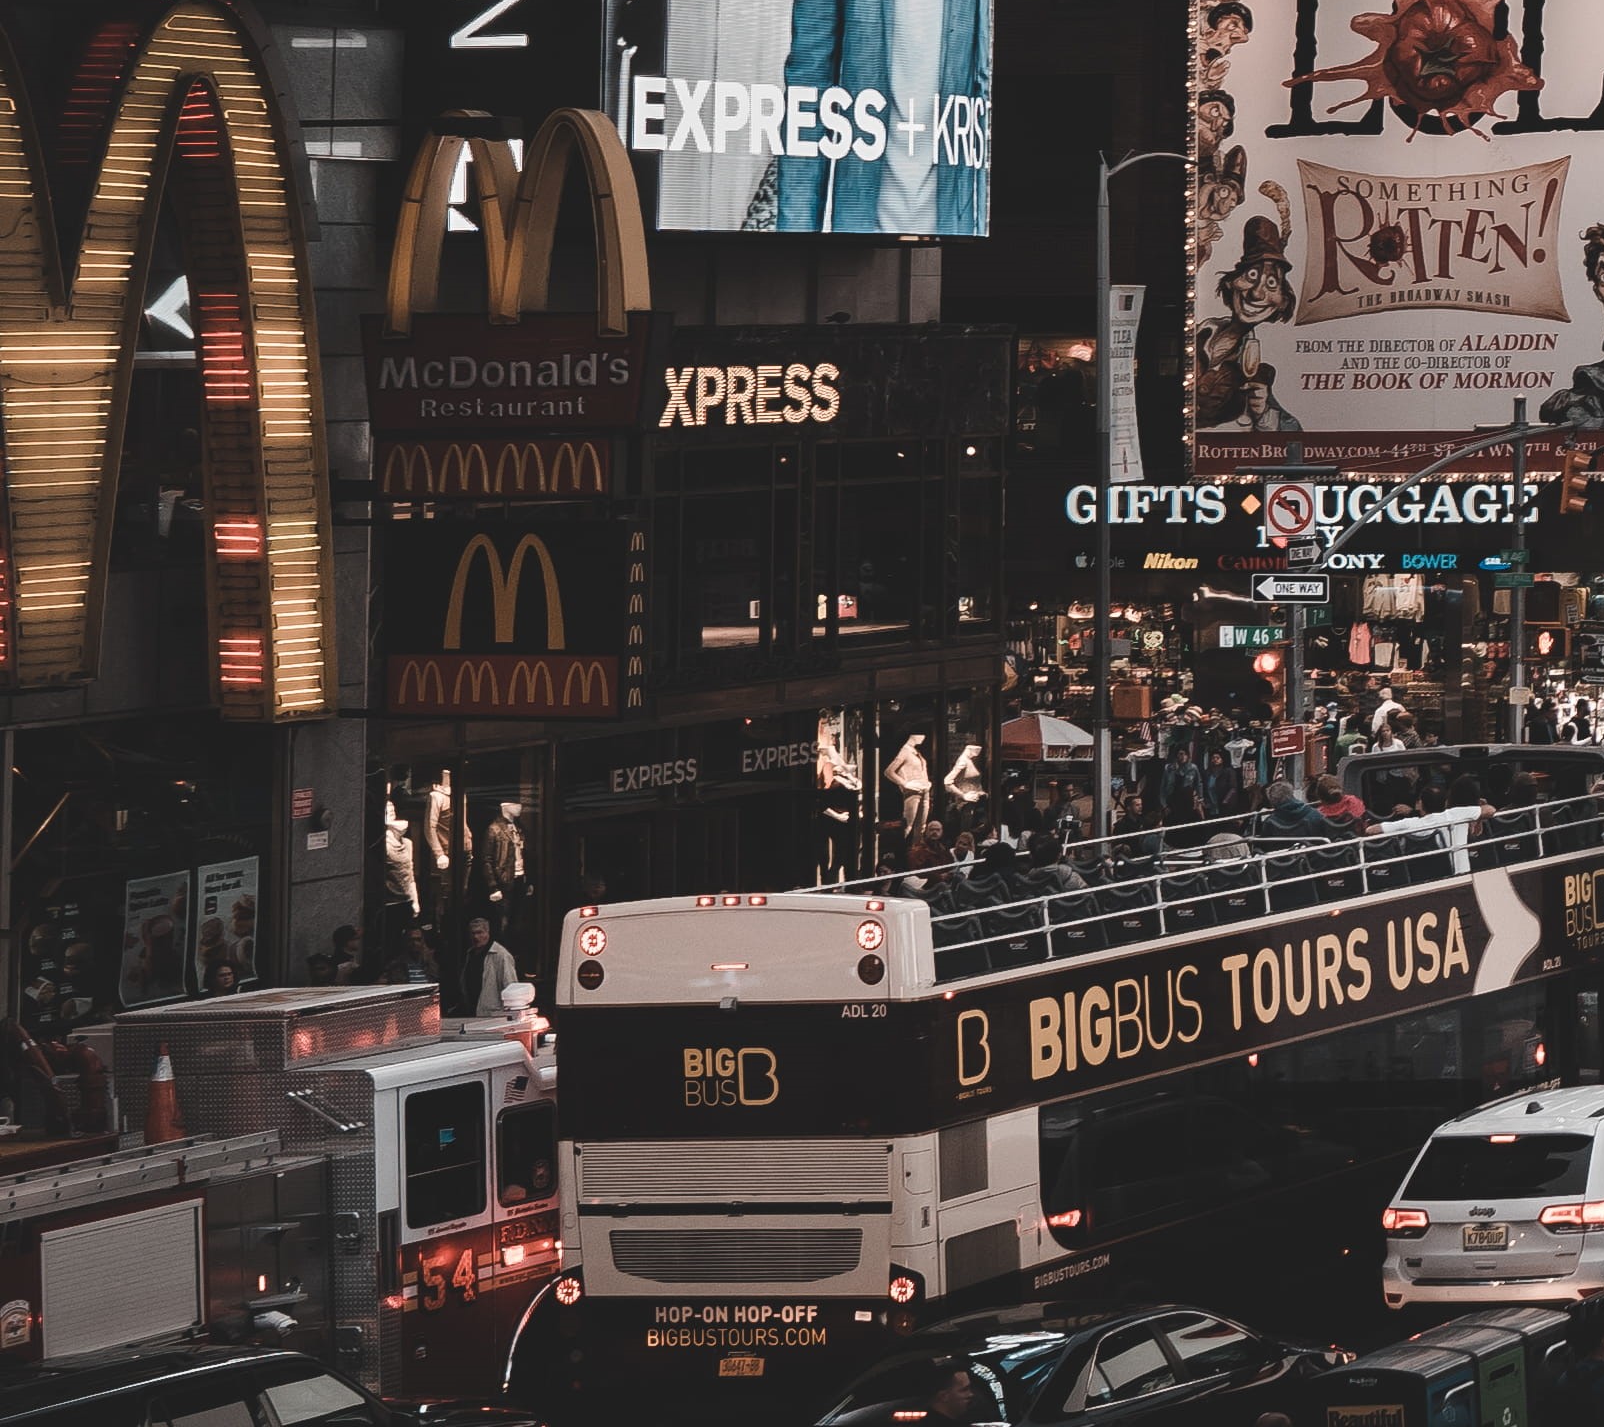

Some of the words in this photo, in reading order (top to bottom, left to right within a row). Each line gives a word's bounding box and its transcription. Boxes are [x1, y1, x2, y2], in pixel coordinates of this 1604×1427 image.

[632, 74, 887, 162] EXPRESS
[931, 93, 983, 168] KRIS
[1336, 173, 1532, 203] SOMETHING
[1358, 294, 1385, 308] THE
[1389, 290, 1462, 307] BROADWAY
[1466, 292, 1512, 309] SMASH
[1296, 339, 1331, 354] FROM
[1334, 339, 1365, 354] THE
[1368, 337, 1437, 353] DIRECTOR
[1459, 332, 1558, 352] ALADDIN
[377, 352, 630, 391] McDonald's
[1341, 355, 1369, 370] AND
[1372, 355, 1399, 370] THE
[1403, 354, 1488, 370] CO-DIRECTOR
[658, 362, 840, 428] XPRESS
[1301, 372, 1346, 391] THE
[1350, 372, 1411, 391] BOOK
[1417, 372, 1448, 390] OF
[1453, 371, 1555, 390] MORMON
[419, 395, 587, 418] Restaurant
[1065, 484, 1227, 525] GIFTS
[1143, 552, 1199, 571] Nikon
[1402, 553, 1458, 569] BOWER
[1273, 581, 1295, 595] ONE
[1297, 581, 1320, 595] WAY
[741, 741, 820, 773] EXPRESS
[612, 758, 698, 793] EXPRESS
[1564, 872, 1594, 908] BIG
[1028, 963, 1203, 1083] BIGBUS
[1220, 927, 1373, 1032] TOURS
[1387, 906, 1470, 991] USA
[840, 1004, 868, 1018] ADL
[872, 1004, 888, 1017] 20
[683, 1048, 736, 1076] BIG
[684, 1079, 737, 1107] BUS
[421, 1248, 477, 1313] 54
[1034, 1253, 1111, 1290] BIGBUSTOURS.COM
[655, 1305, 728, 1323] HOP-ON
[733, 1305, 818, 1322] HOP-OFF
[646, 1327, 827, 1348] BIGBUSTOURS.COM
